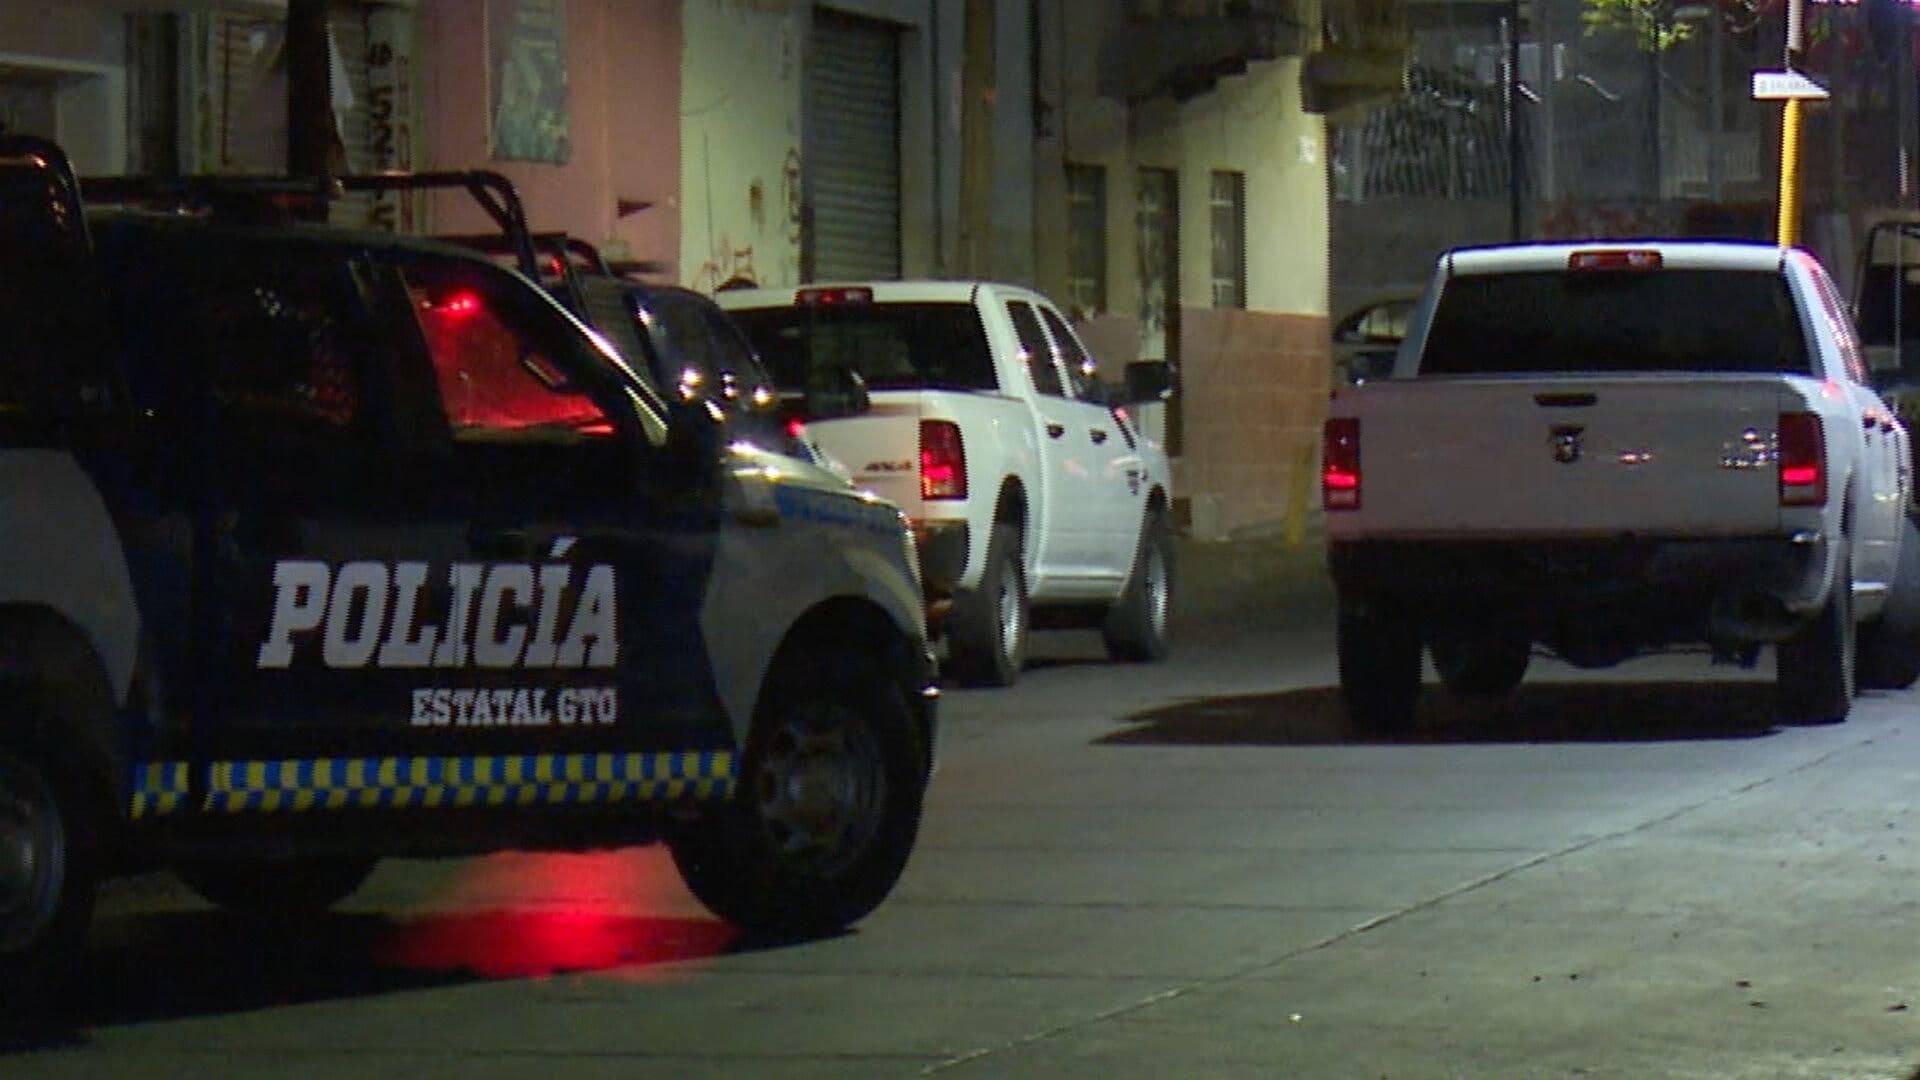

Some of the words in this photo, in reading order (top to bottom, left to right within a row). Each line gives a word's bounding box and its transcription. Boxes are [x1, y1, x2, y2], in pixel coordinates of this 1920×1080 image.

[257, 536, 619, 668] POLICÍA
[411, 688, 551, 727] ESTATAL
[558, 687, 618, 726] GTO
